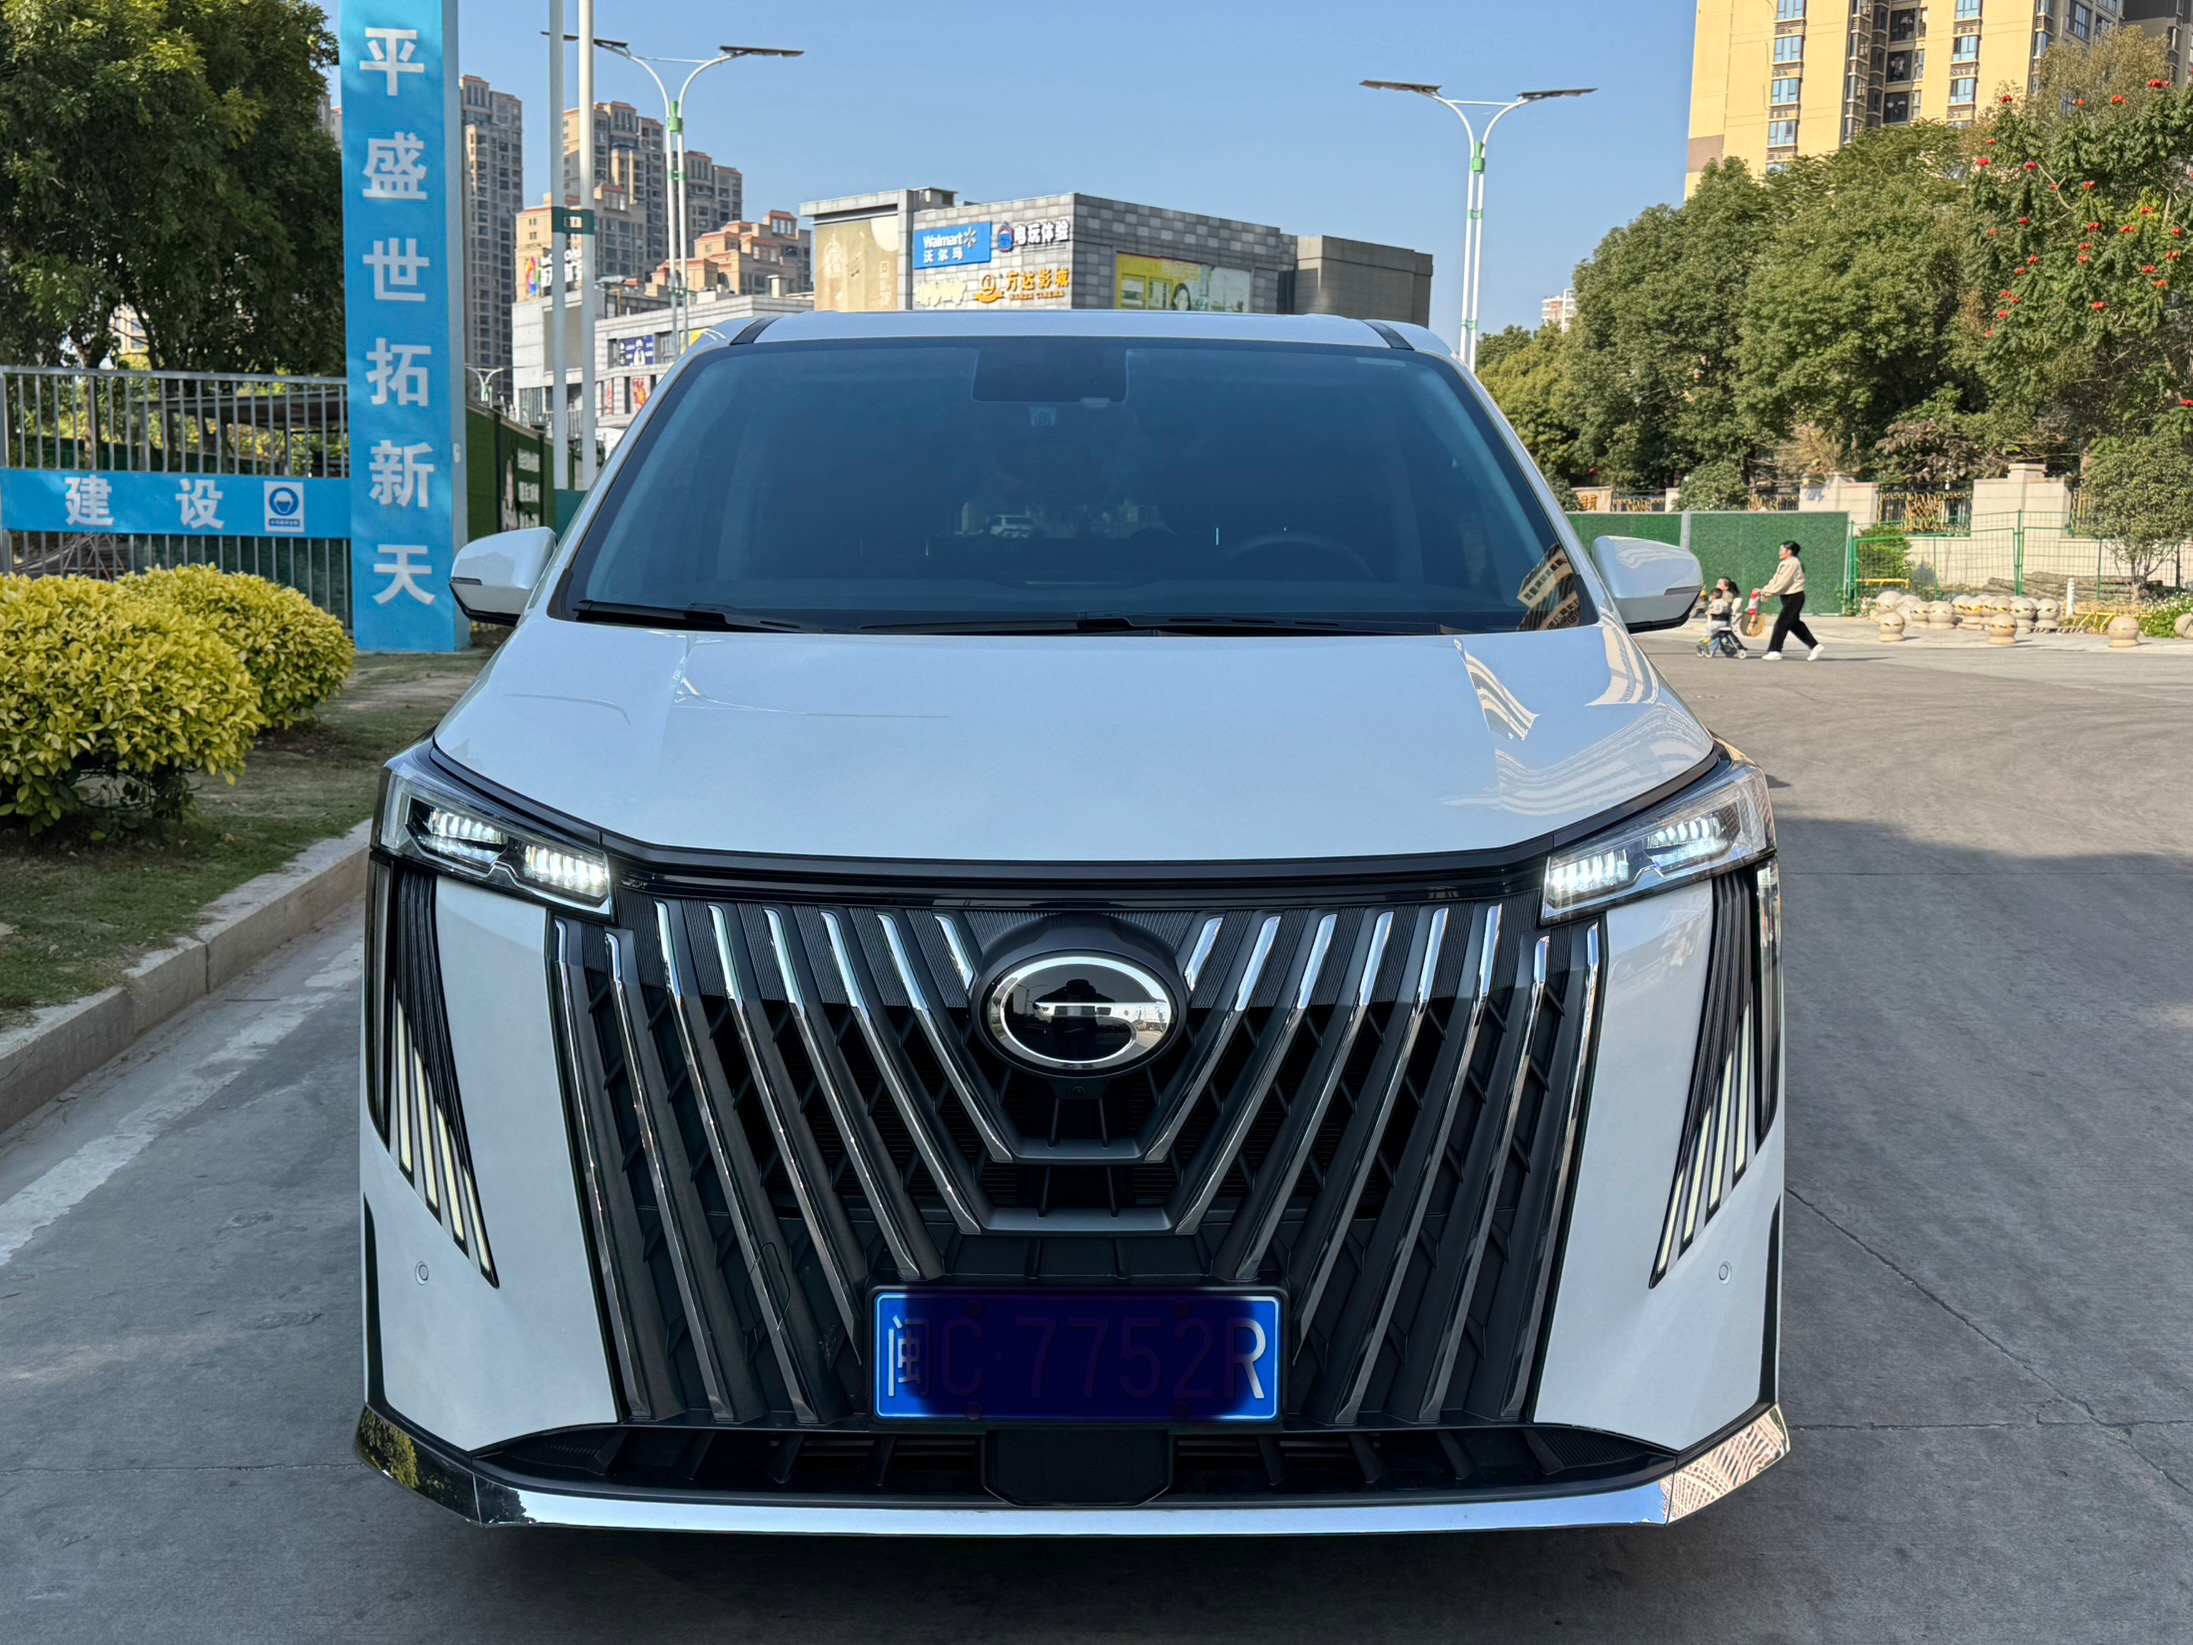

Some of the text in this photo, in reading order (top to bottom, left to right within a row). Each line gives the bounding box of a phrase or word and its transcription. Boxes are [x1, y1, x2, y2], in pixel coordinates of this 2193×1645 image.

[923, 232, 963, 249] Walmart
[1014, 219, 1070, 246] 电玩体验
[923, 247, 963, 263] 沃尔玛
[1006, 267, 1070, 292] 万达影城
[358, 26, 437, 607] 平盛世拓新天
[64, 475, 225, 529] 建设
